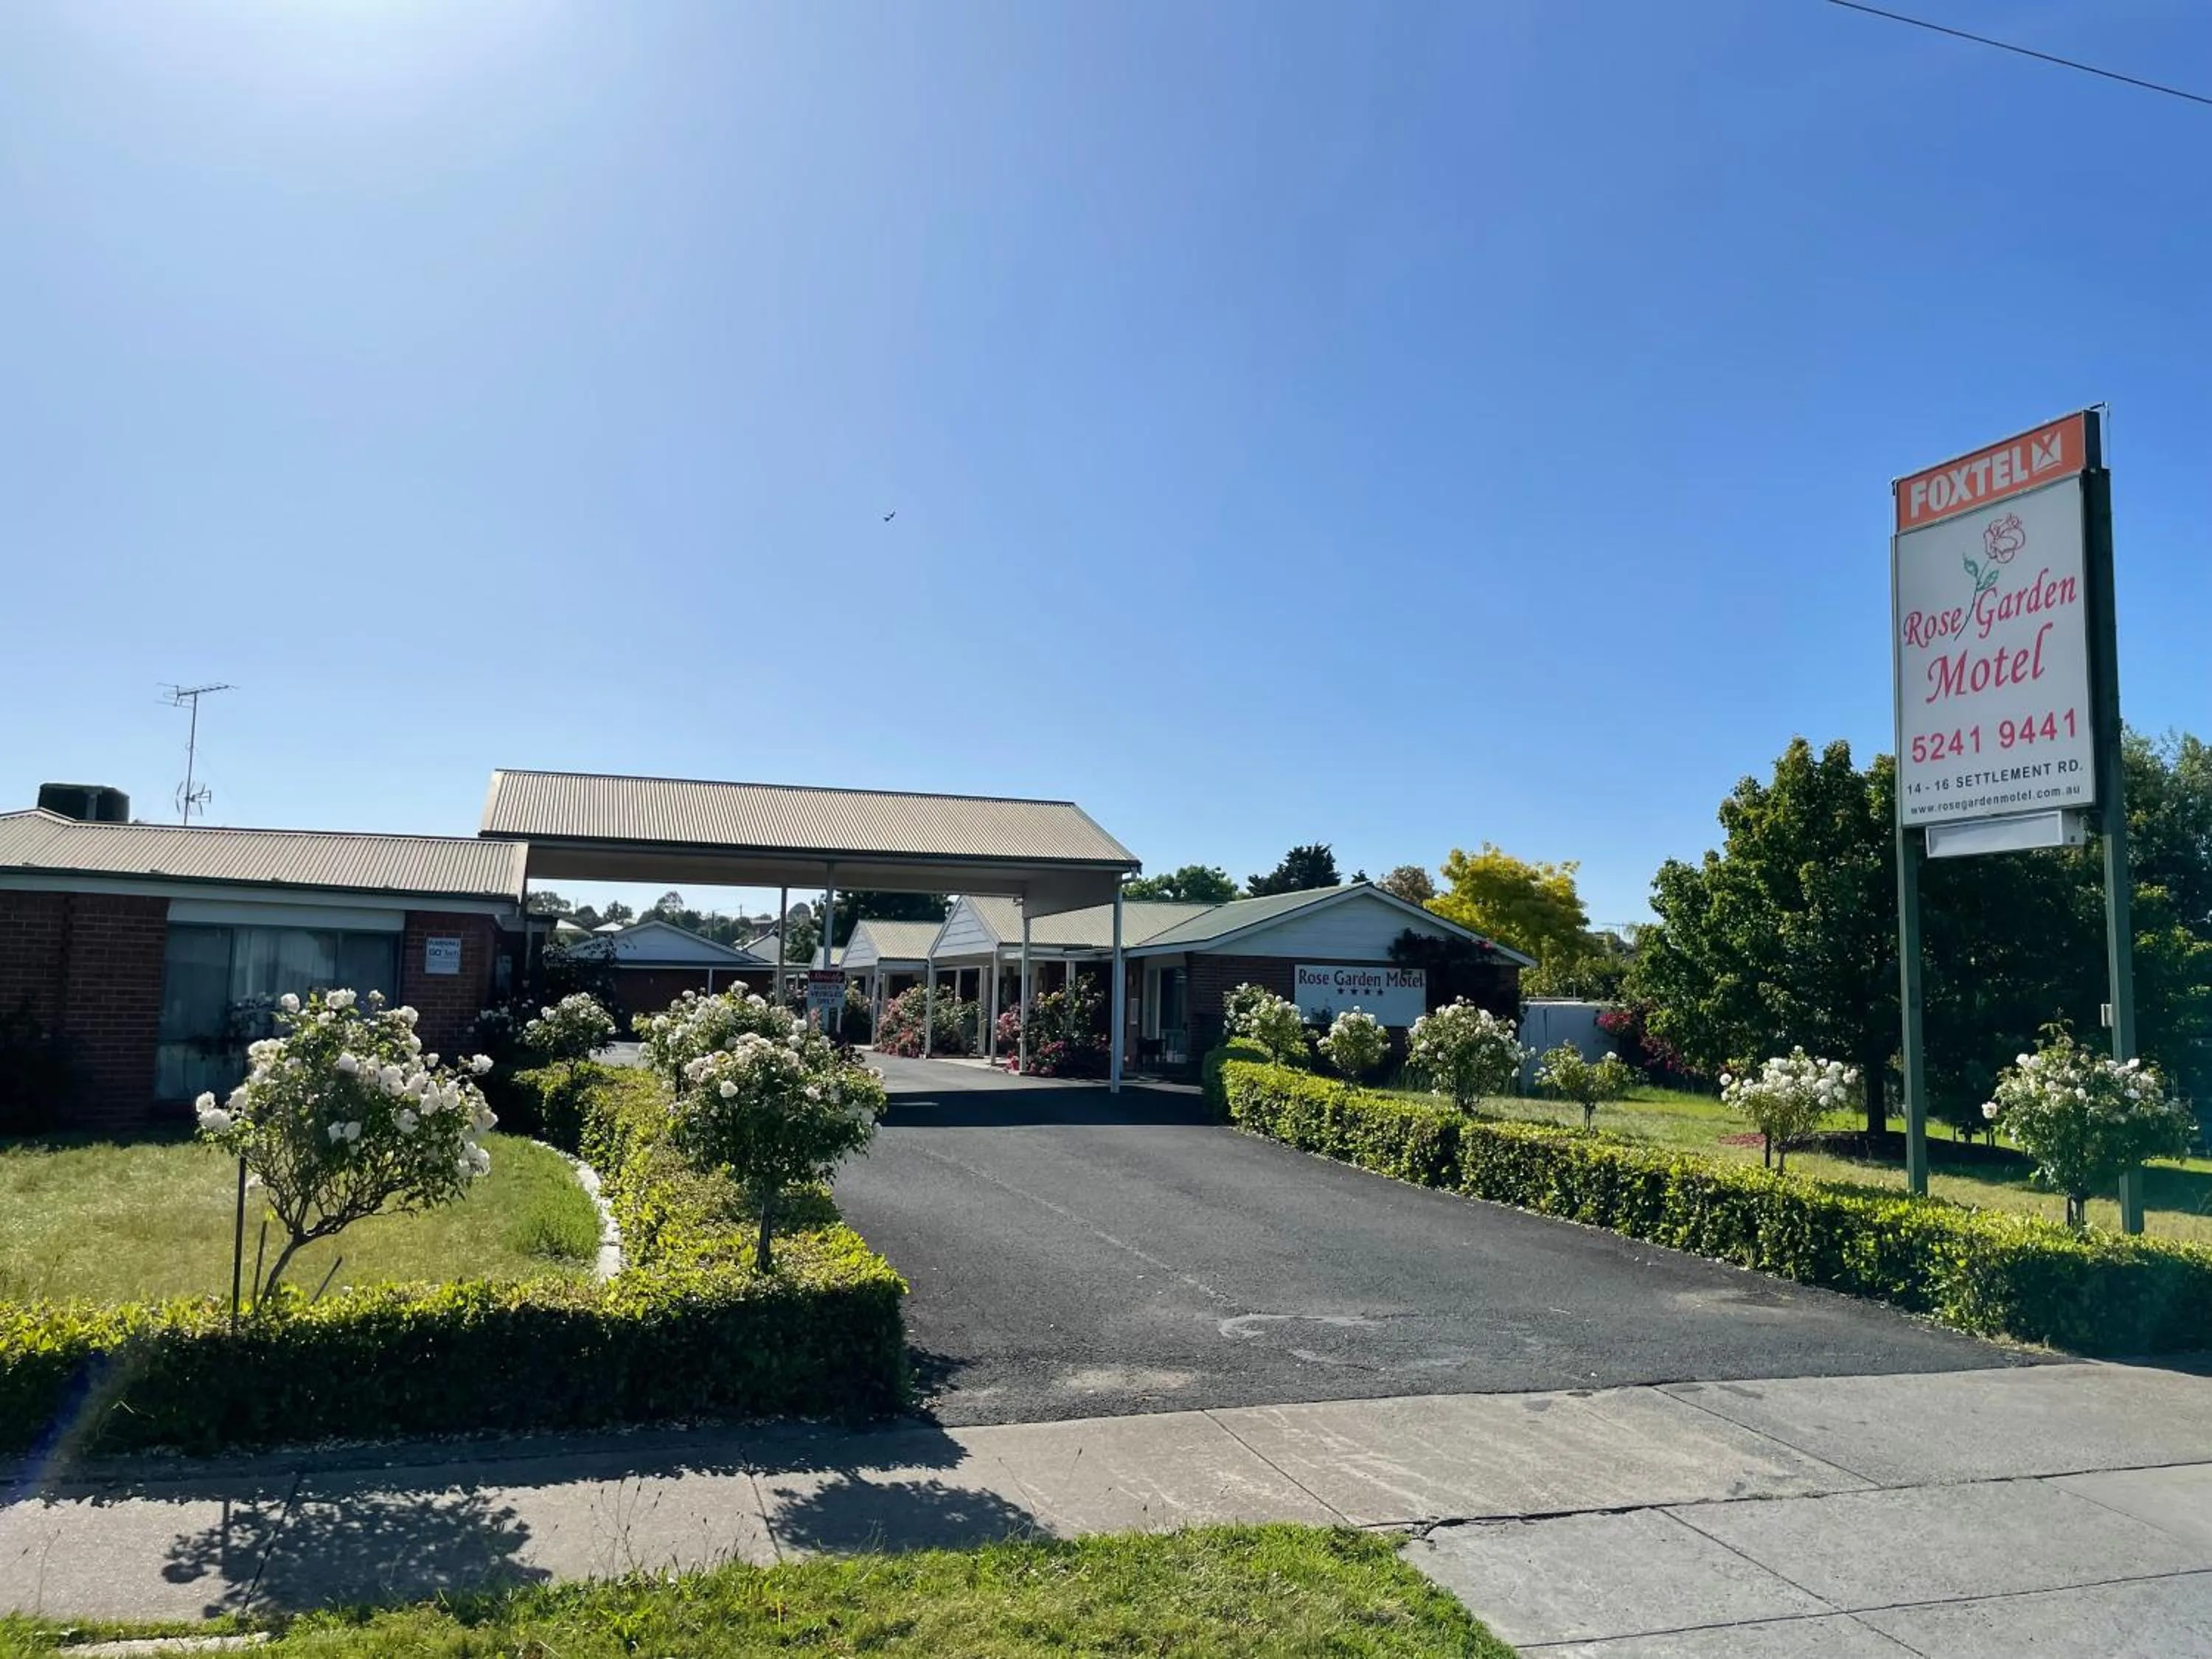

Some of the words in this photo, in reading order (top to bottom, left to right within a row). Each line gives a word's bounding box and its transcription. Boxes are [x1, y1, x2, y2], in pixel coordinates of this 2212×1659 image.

[1910, 445, 2028, 518] FOXTEL
[1903, 611, 1963, 648] Rose
[1975, 567, 2077, 639] Garden
[1925, 622, 2053, 703] Motel
[1911, 725, 1980, 764] 5241
[1999, 707, 2076, 749] 9441
[1907, 783, 1921, 796] 14
[1935, 778, 1950, 792] 16
[1956, 762, 2052, 789] SETTLEMENT
[1910, 784, 2081, 815] www.rosegardenmotel.com.au
[1298, 968, 1329, 986] Rose
[1334, 970, 1381, 987] Garden
[1386, 971, 1424, 988] Motel
